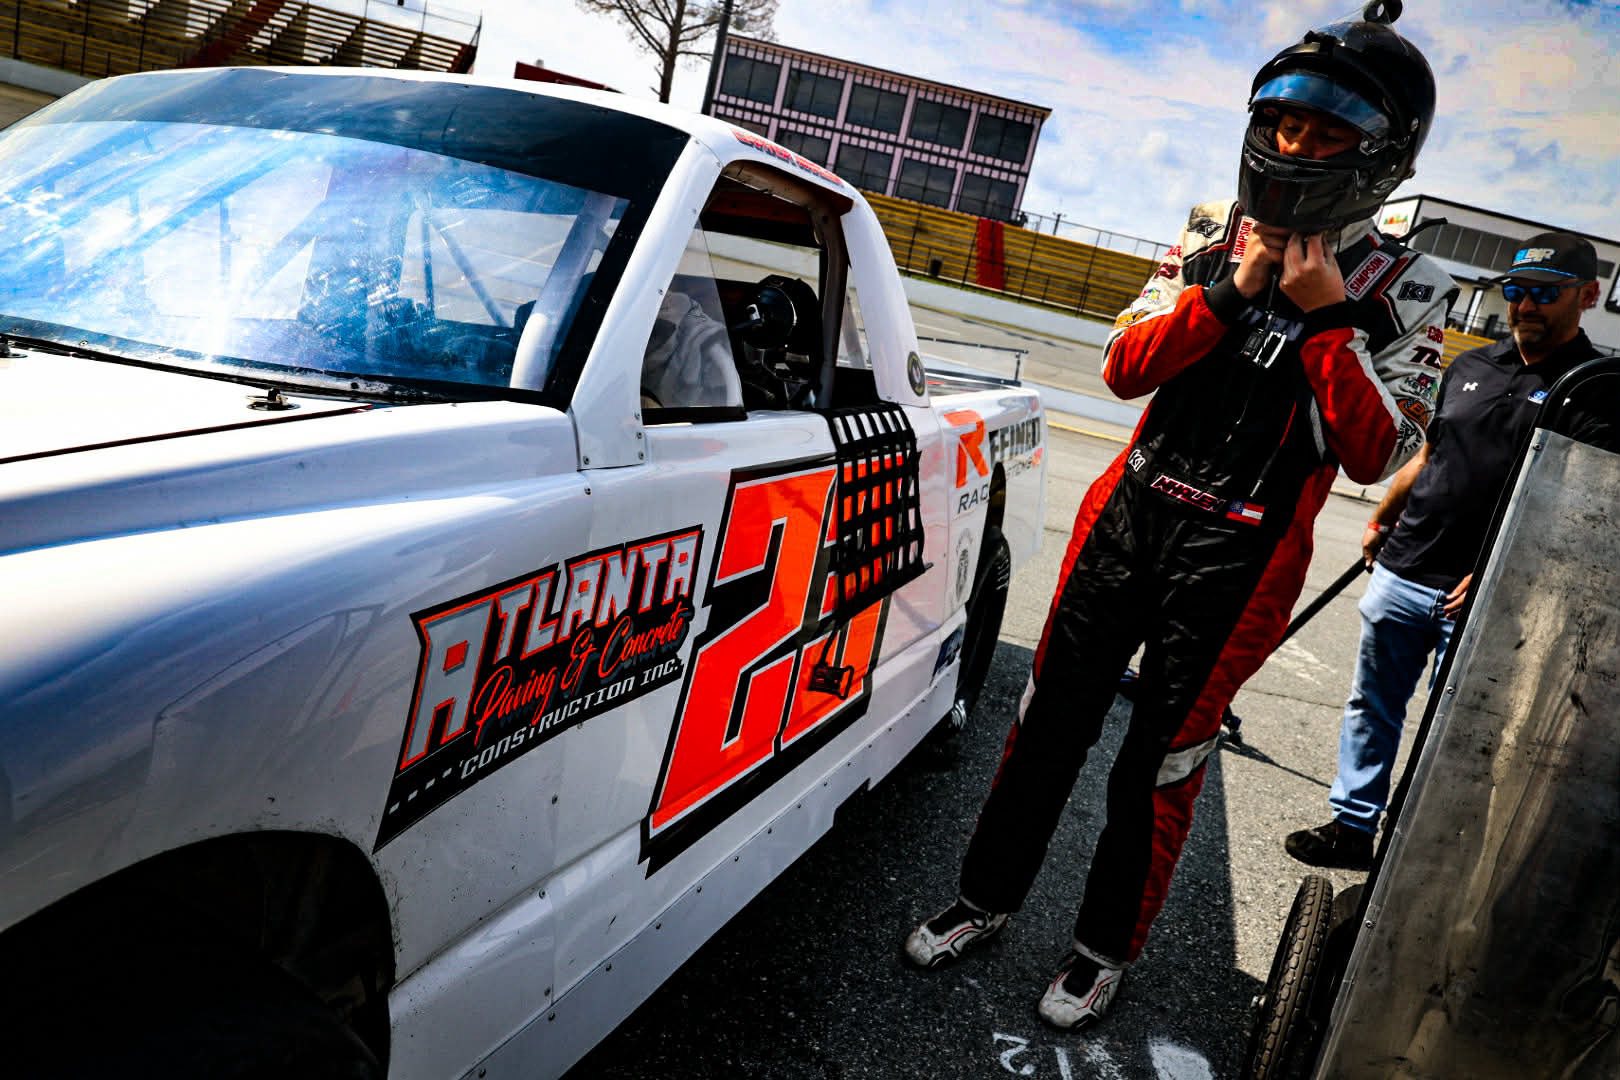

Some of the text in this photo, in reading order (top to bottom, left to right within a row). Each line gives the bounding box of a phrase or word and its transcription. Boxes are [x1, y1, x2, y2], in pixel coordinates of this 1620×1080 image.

[1349, 255, 1386, 294] SIMPSON
[957, 483, 989, 514] RAC
[399, 530, 701, 771] ATLANTA
[473, 601, 689, 748] Paving & Concrete
[640, 657, 679, 686] INC.
